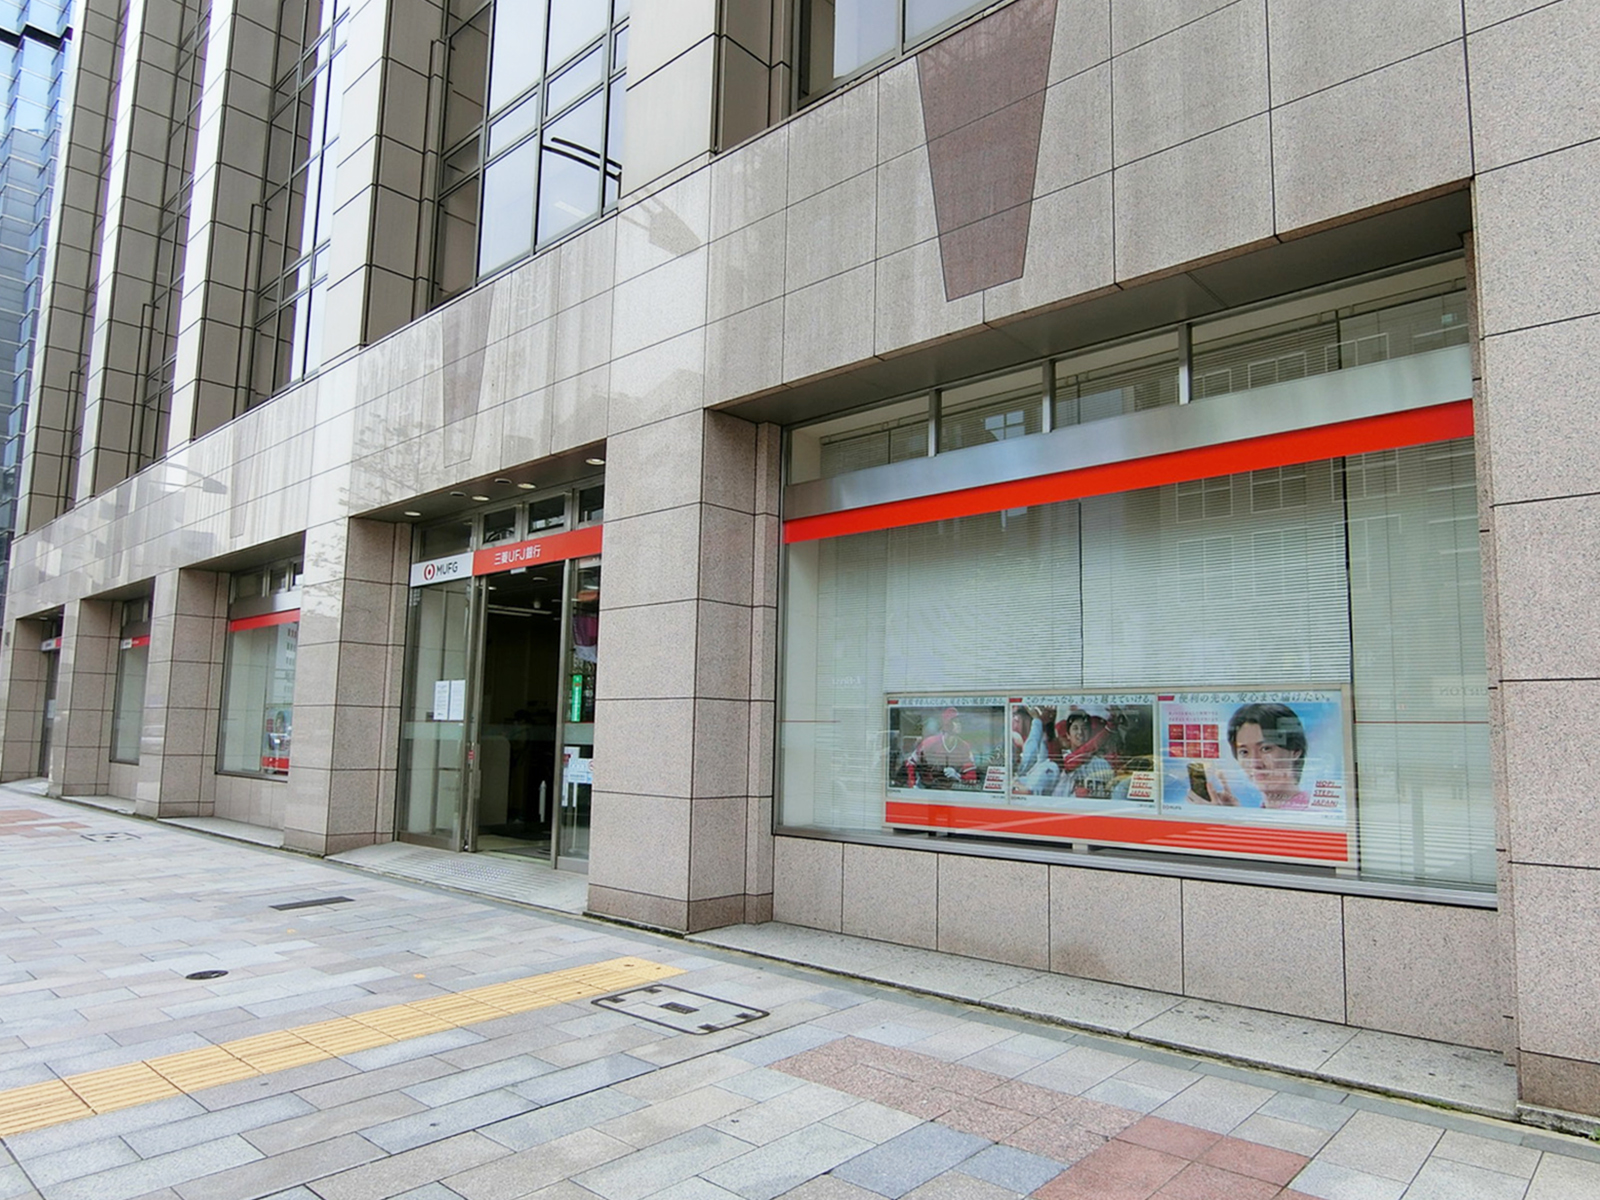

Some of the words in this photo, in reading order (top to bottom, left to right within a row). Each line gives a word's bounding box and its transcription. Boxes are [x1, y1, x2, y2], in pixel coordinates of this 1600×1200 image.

[493, 545, 542, 565] 三菱UFJ銀行
[436, 561, 459, 577] MUFG
[1178, 691, 1331, 704] 便利の先の、安心まで届けたい。
